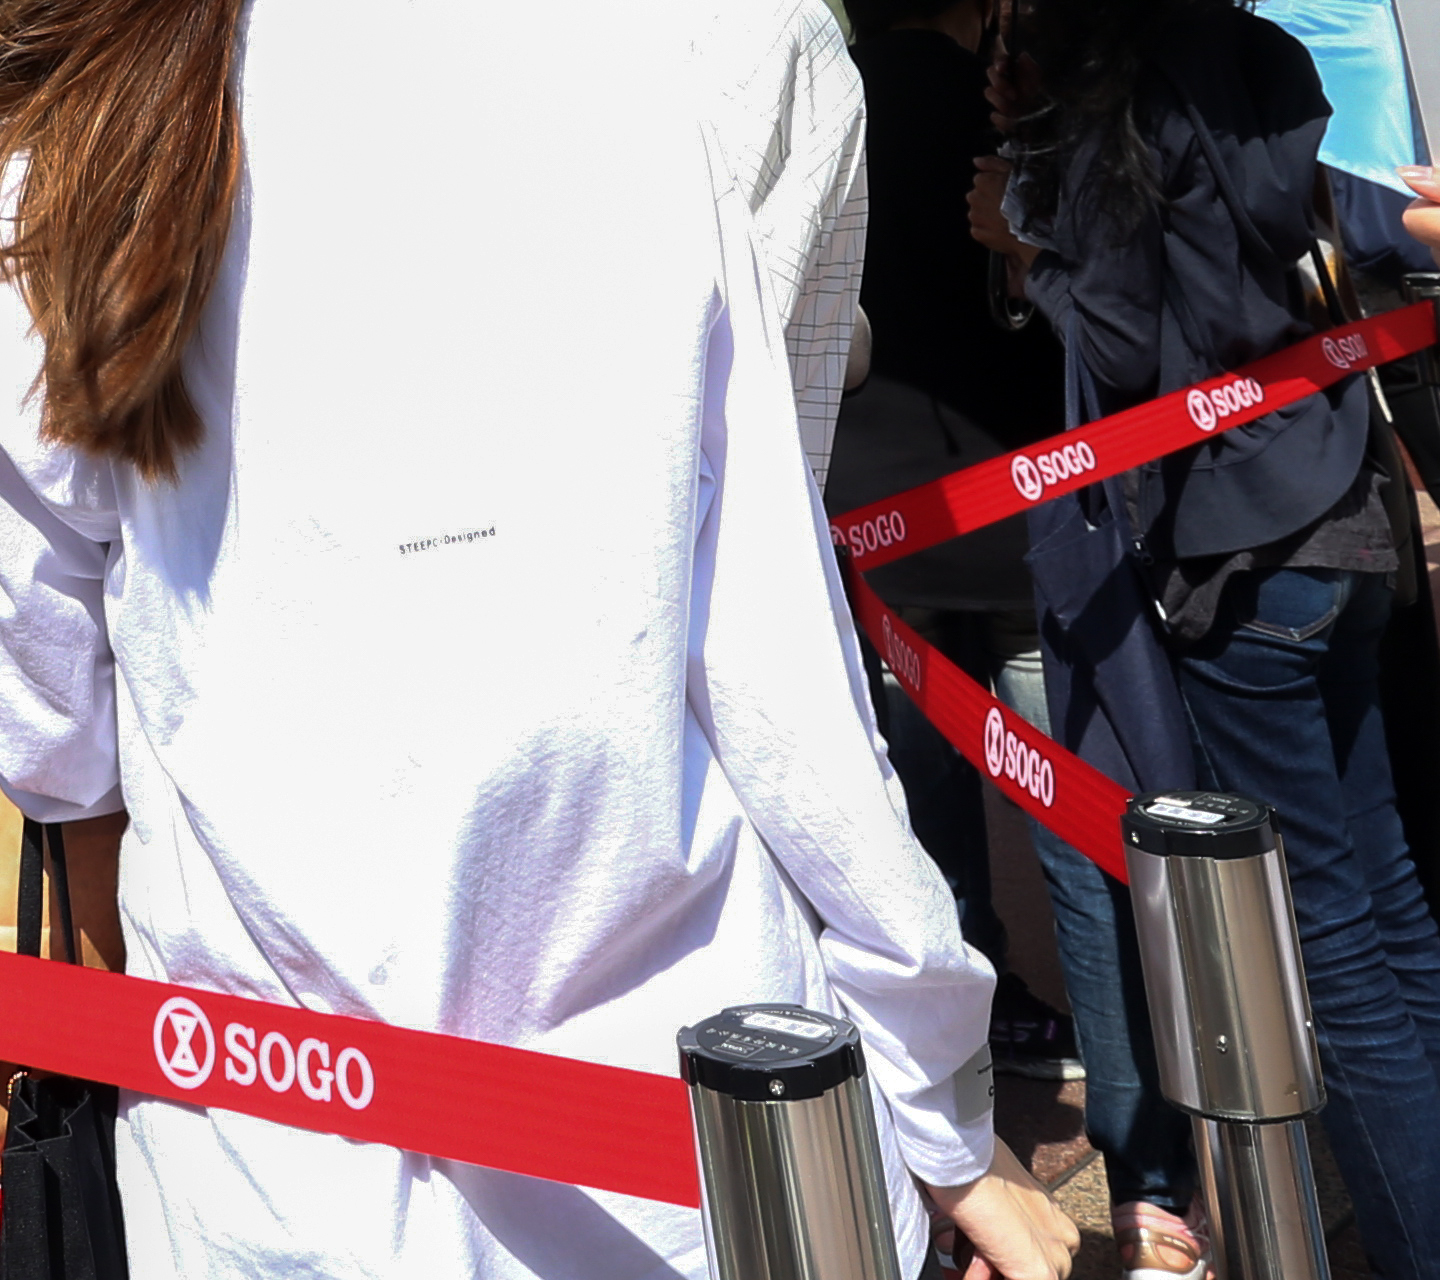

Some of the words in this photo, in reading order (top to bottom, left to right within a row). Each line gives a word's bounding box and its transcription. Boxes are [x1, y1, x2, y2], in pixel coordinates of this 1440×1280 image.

[1213, 376, 1265, 421] SOGO
[1038, 441, 1096, 487] SOGO
[850, 511, 906, 558] SOGO
[1005, 730, 1054, 807] SOGO
[225, 1021, 374, 1109] SOGO
